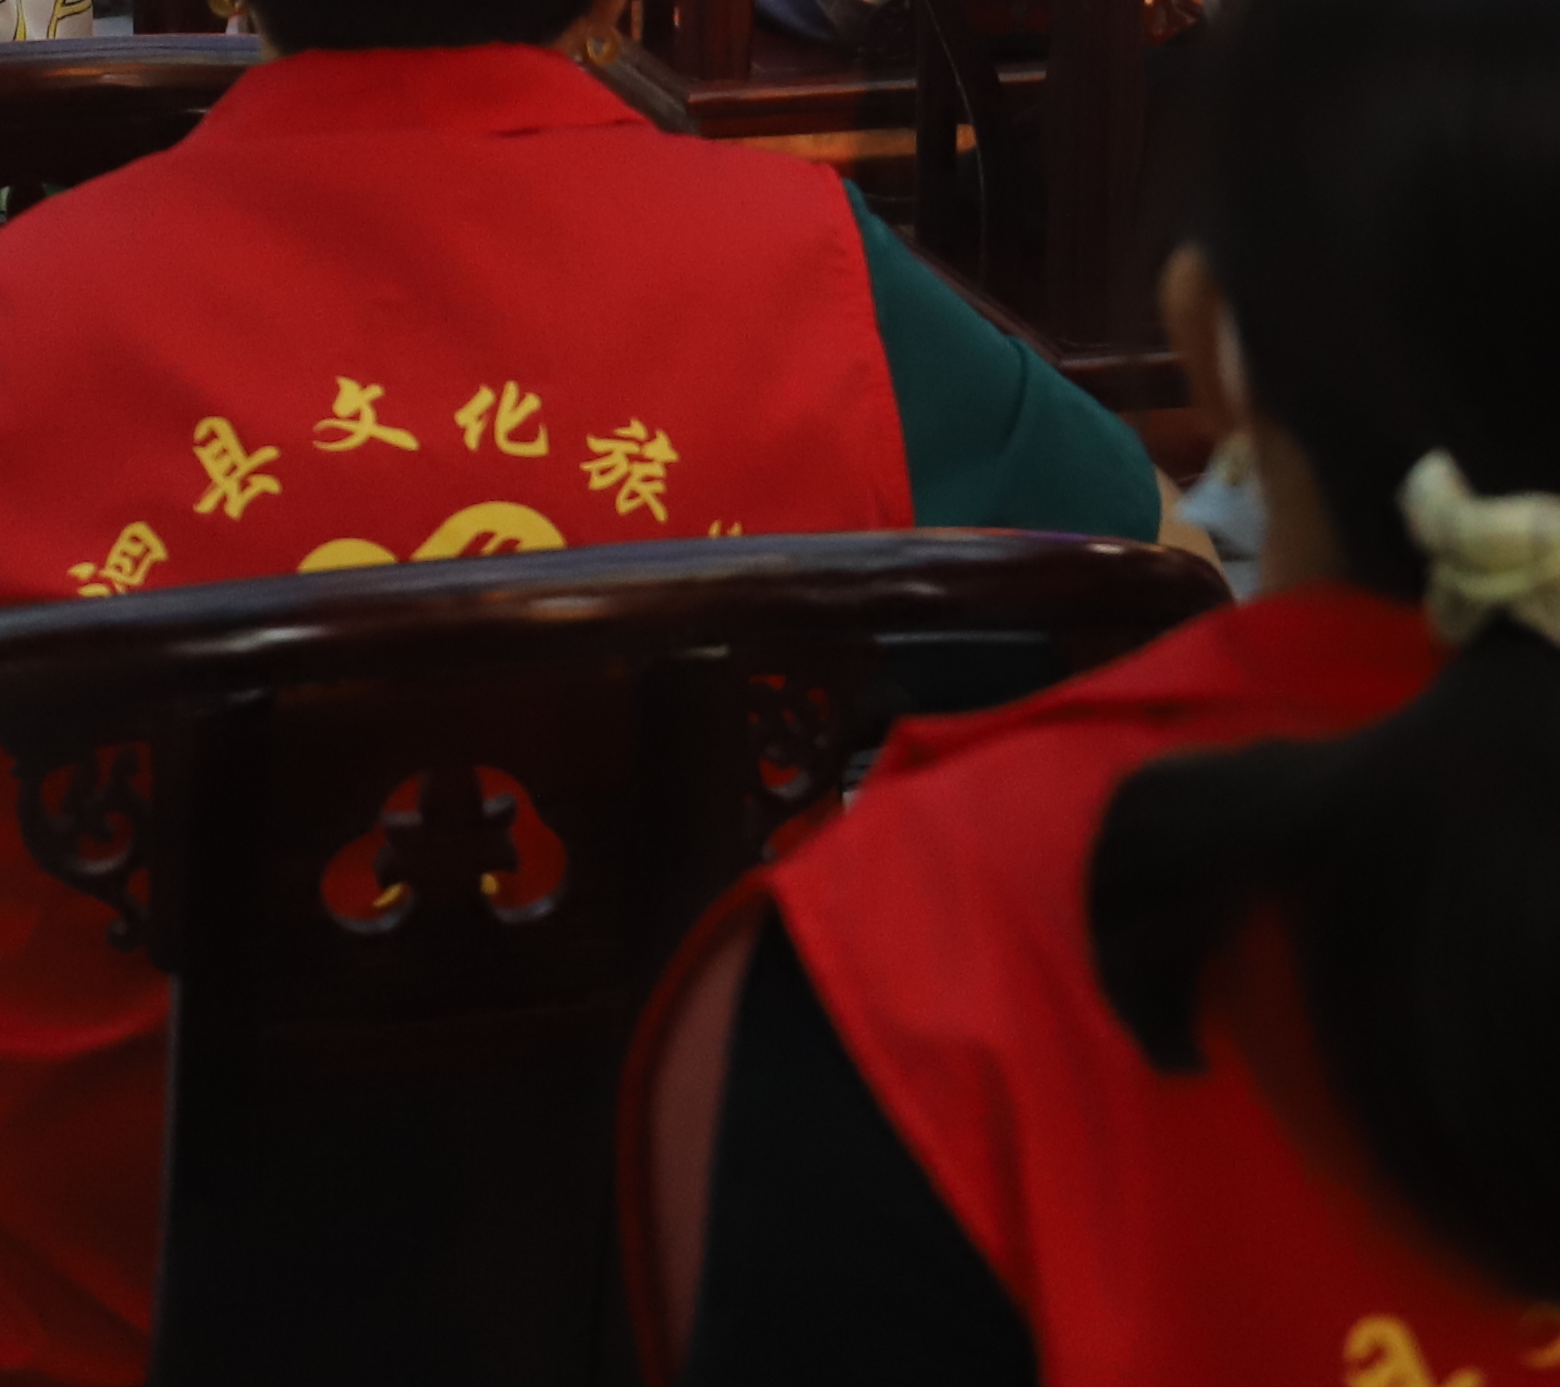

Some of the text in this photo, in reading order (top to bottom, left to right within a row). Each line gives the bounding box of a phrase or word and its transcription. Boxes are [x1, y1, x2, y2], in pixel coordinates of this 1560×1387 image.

[67, 375, 745, 599] 泗县文化旅
